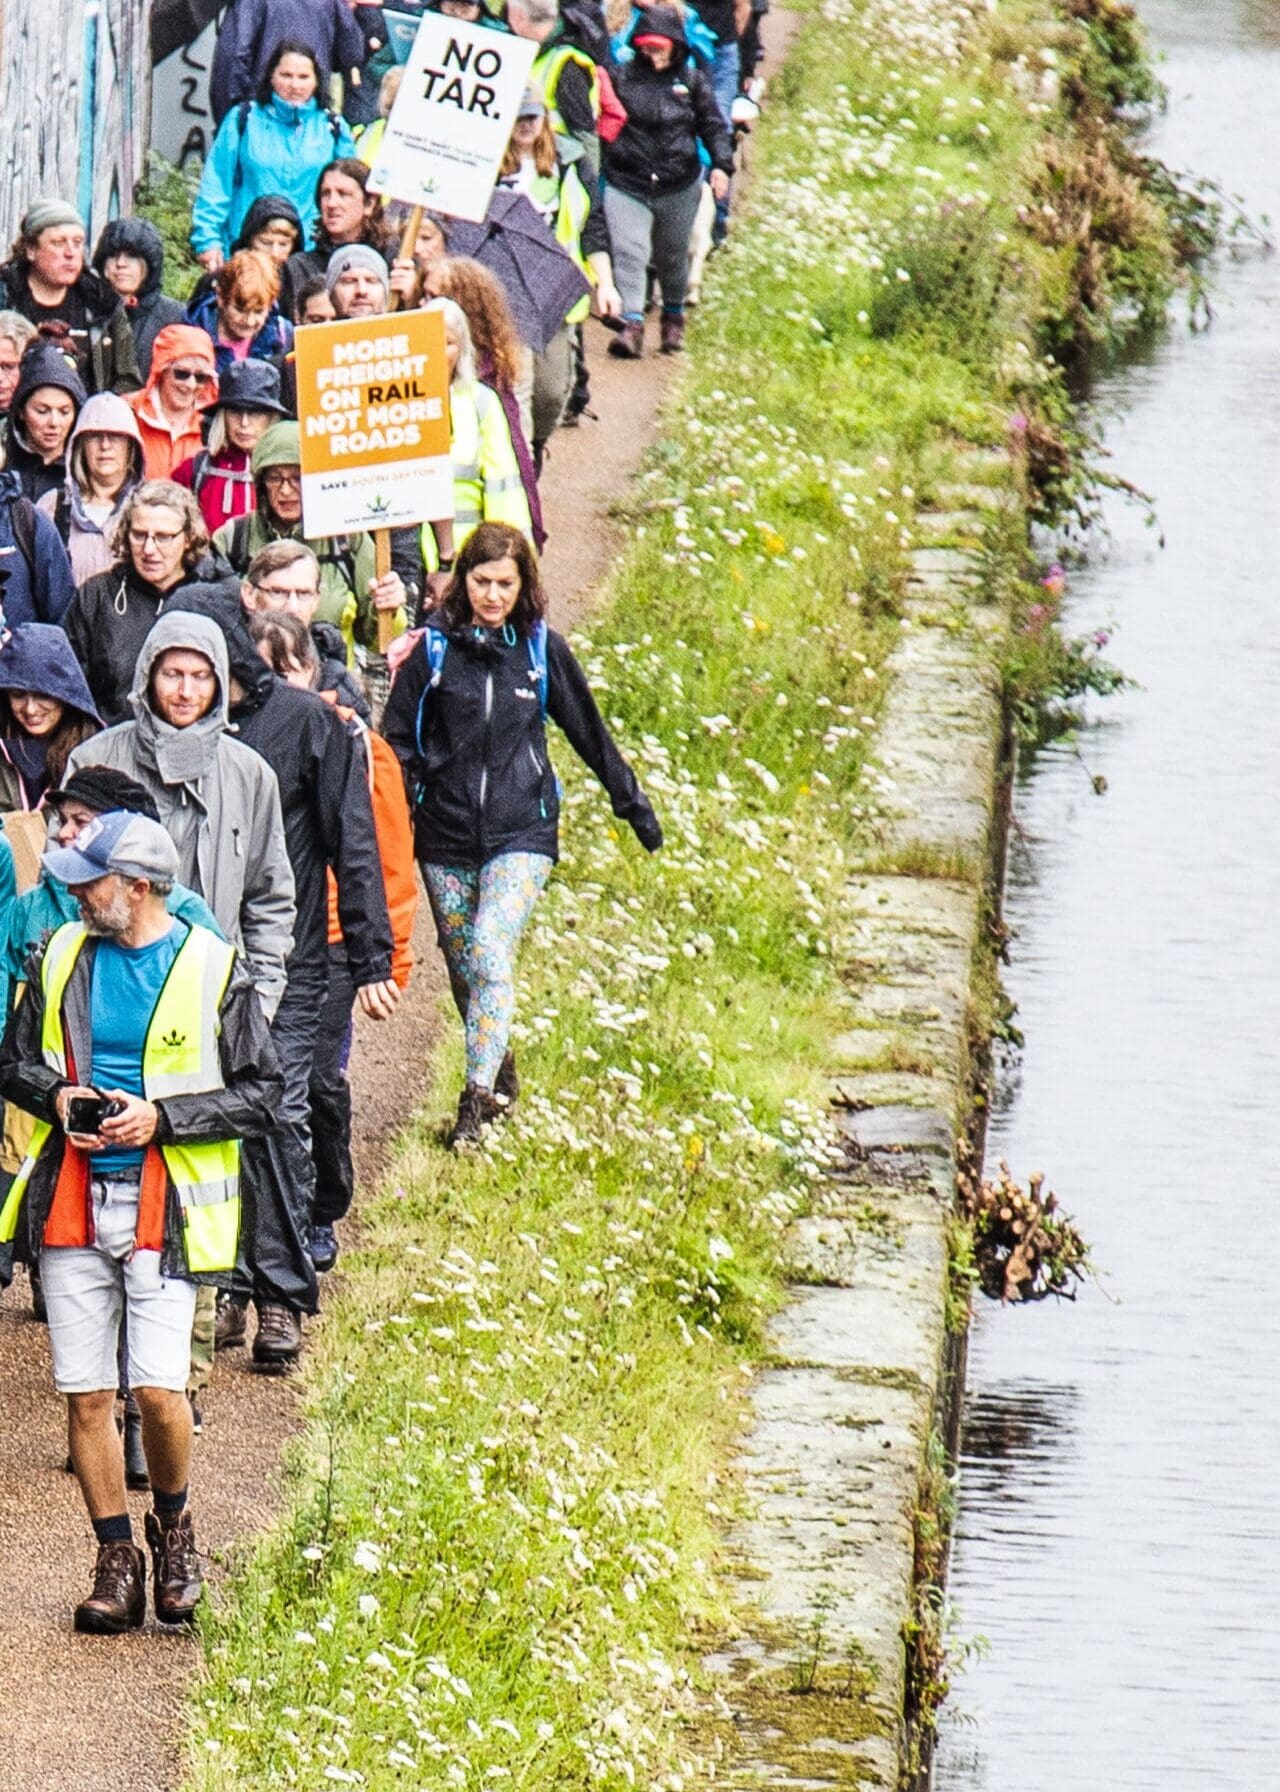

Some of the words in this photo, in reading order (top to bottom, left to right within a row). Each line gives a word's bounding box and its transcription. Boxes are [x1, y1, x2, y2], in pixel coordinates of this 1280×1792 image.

[442, 37, 502, 78] NO
[423, 68, 500, 120] TAR.
[333, 334, 410, 365] MORE
[316, 354, 428, 390] FREIGHT
[320, 386, 361, 412] ON
[367, 380, 426, 404] RAIL
[306, 408, 361, 438] NOT
[367, 397, 443, 428] MORE
[329, 424, 422, 457] ROADS
[321, 480, 348, 491] SAVE
